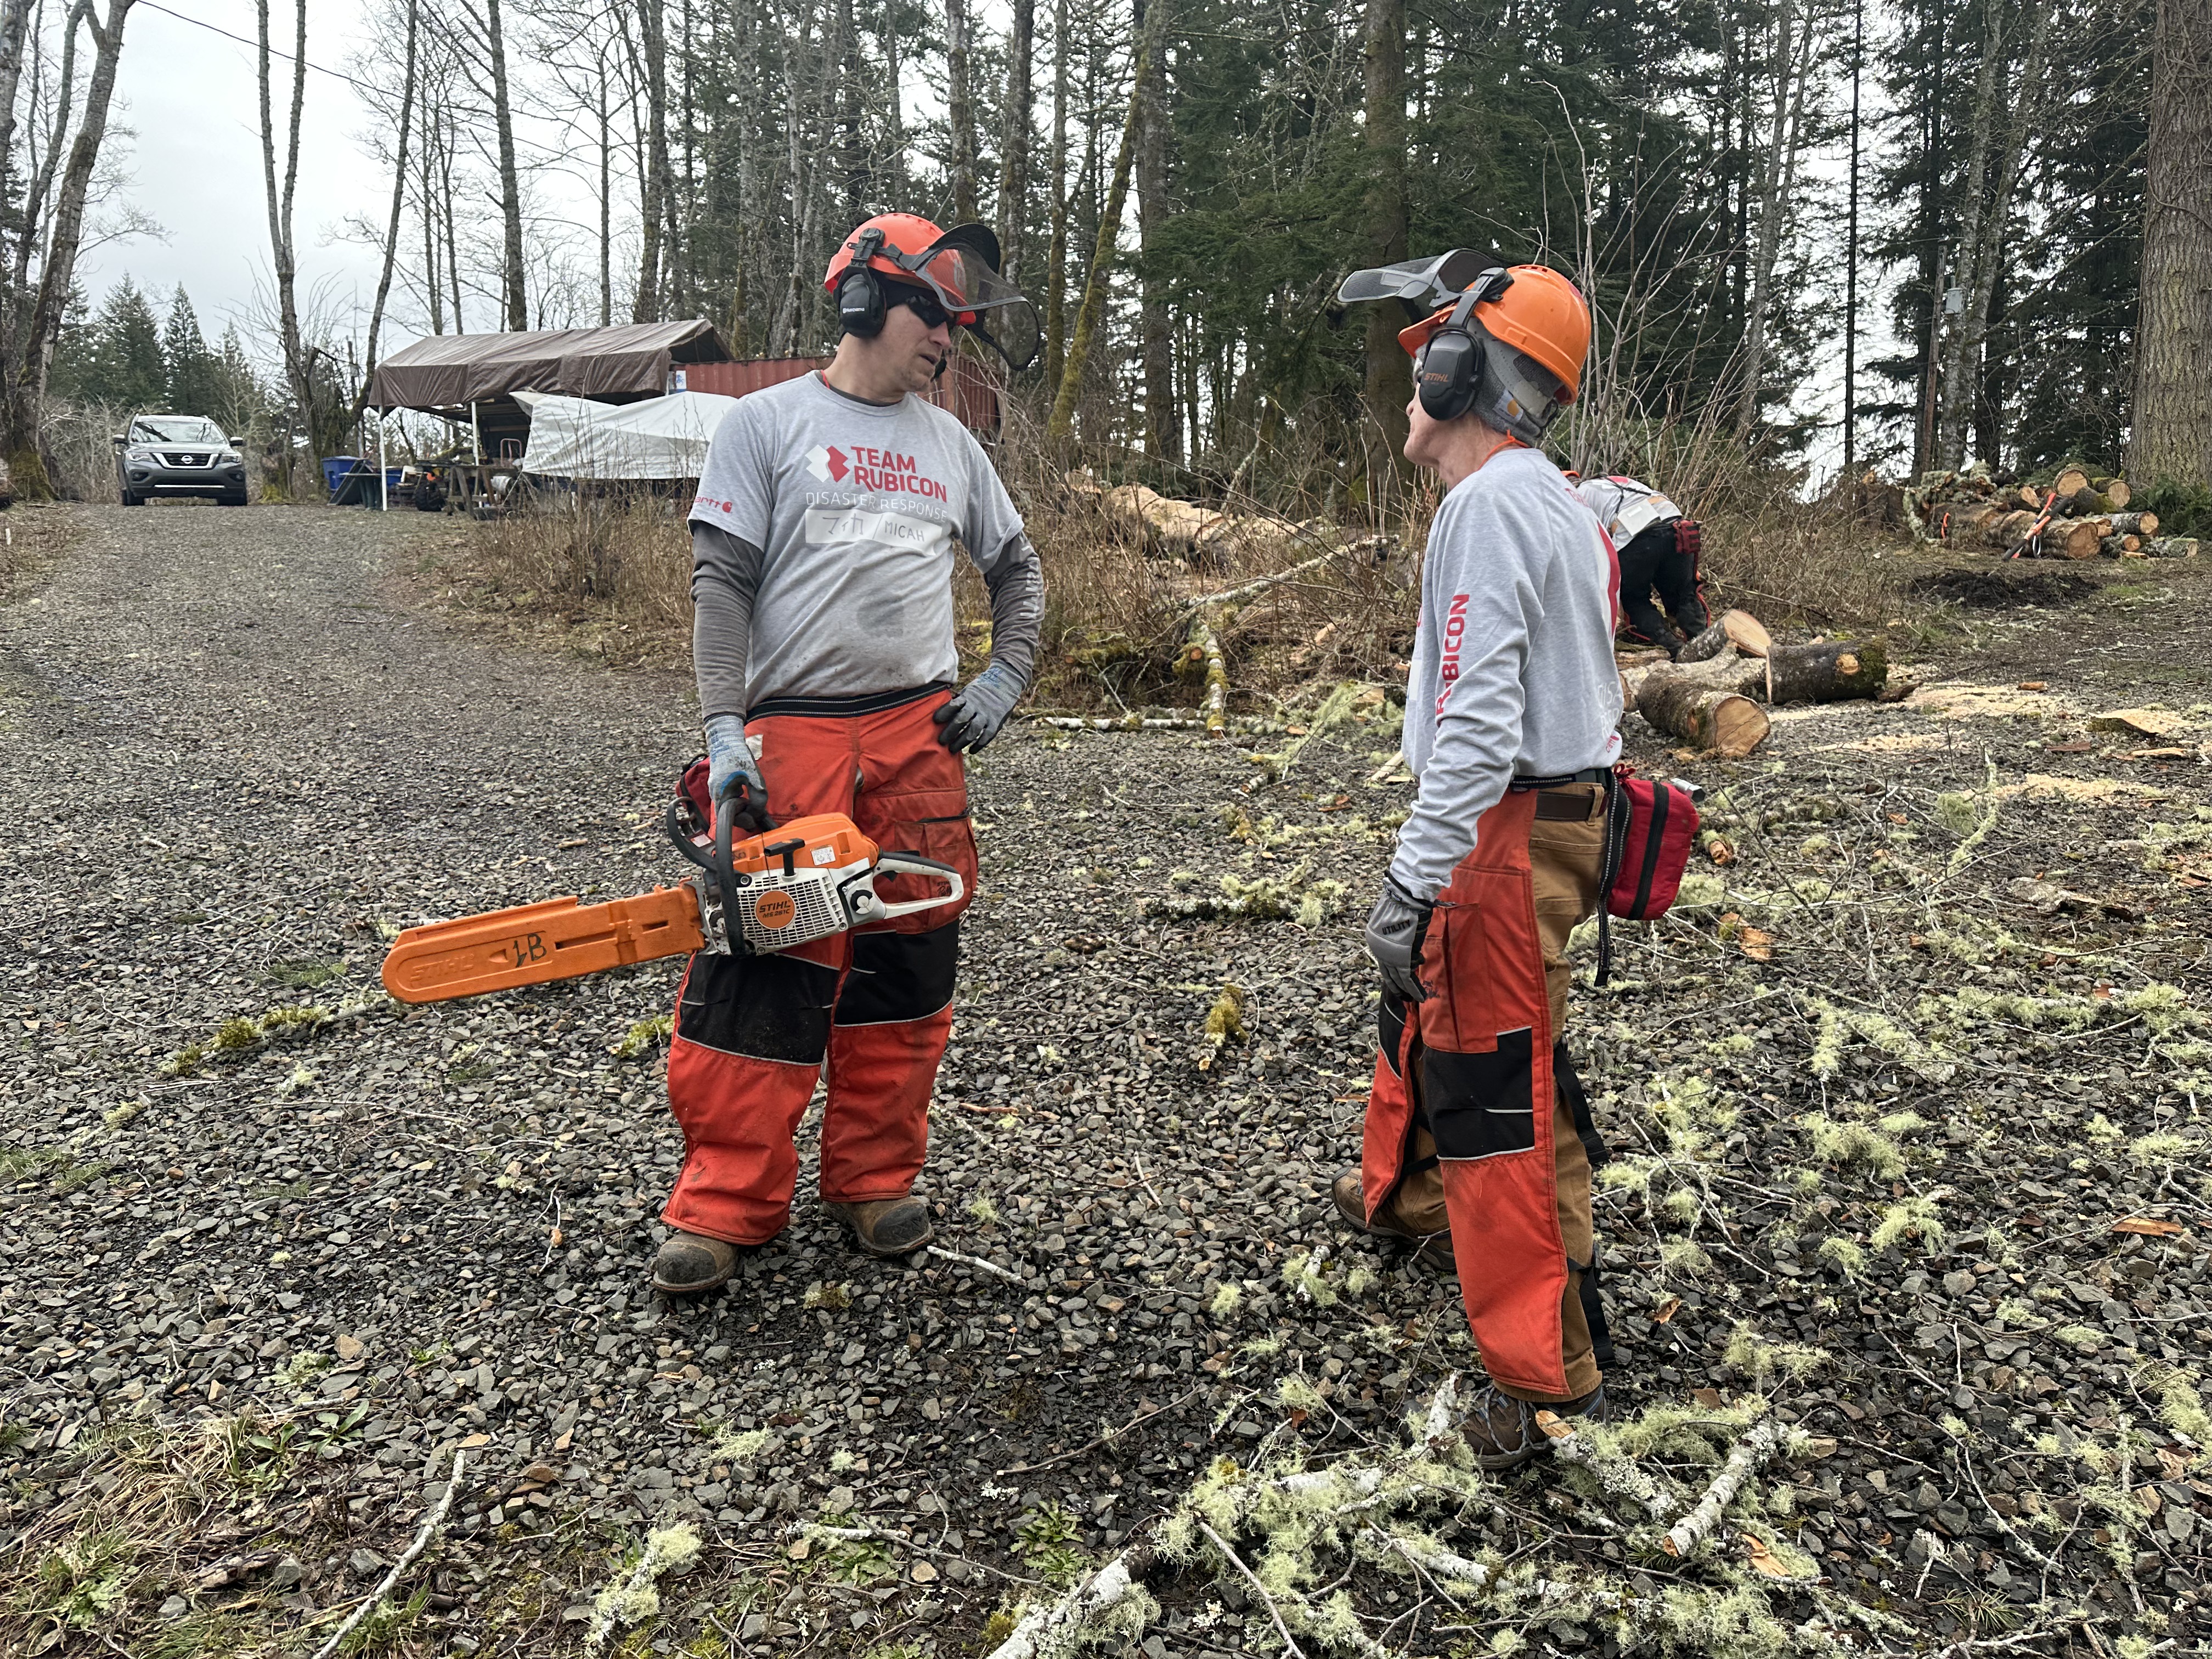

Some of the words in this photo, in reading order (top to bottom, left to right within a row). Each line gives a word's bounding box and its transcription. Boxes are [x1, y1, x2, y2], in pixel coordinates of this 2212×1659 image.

[1424, 373, 1448, 382] STIHL
[851, 446, 916, 473] TEAM
[854, 465, 947, 503] RUBICON
[806, 492, 876, 509] DISASTER
[880, 499, 947, 523] RESPONSE
[884, 520, 925, 542] MICAH
[1435, 594, 1470, 716] RBICON
[759, 900, 791, 913] STIHL
[1382, 919, 1410, 935] UTILITY
[410, 955, 475, 981] STIHL
